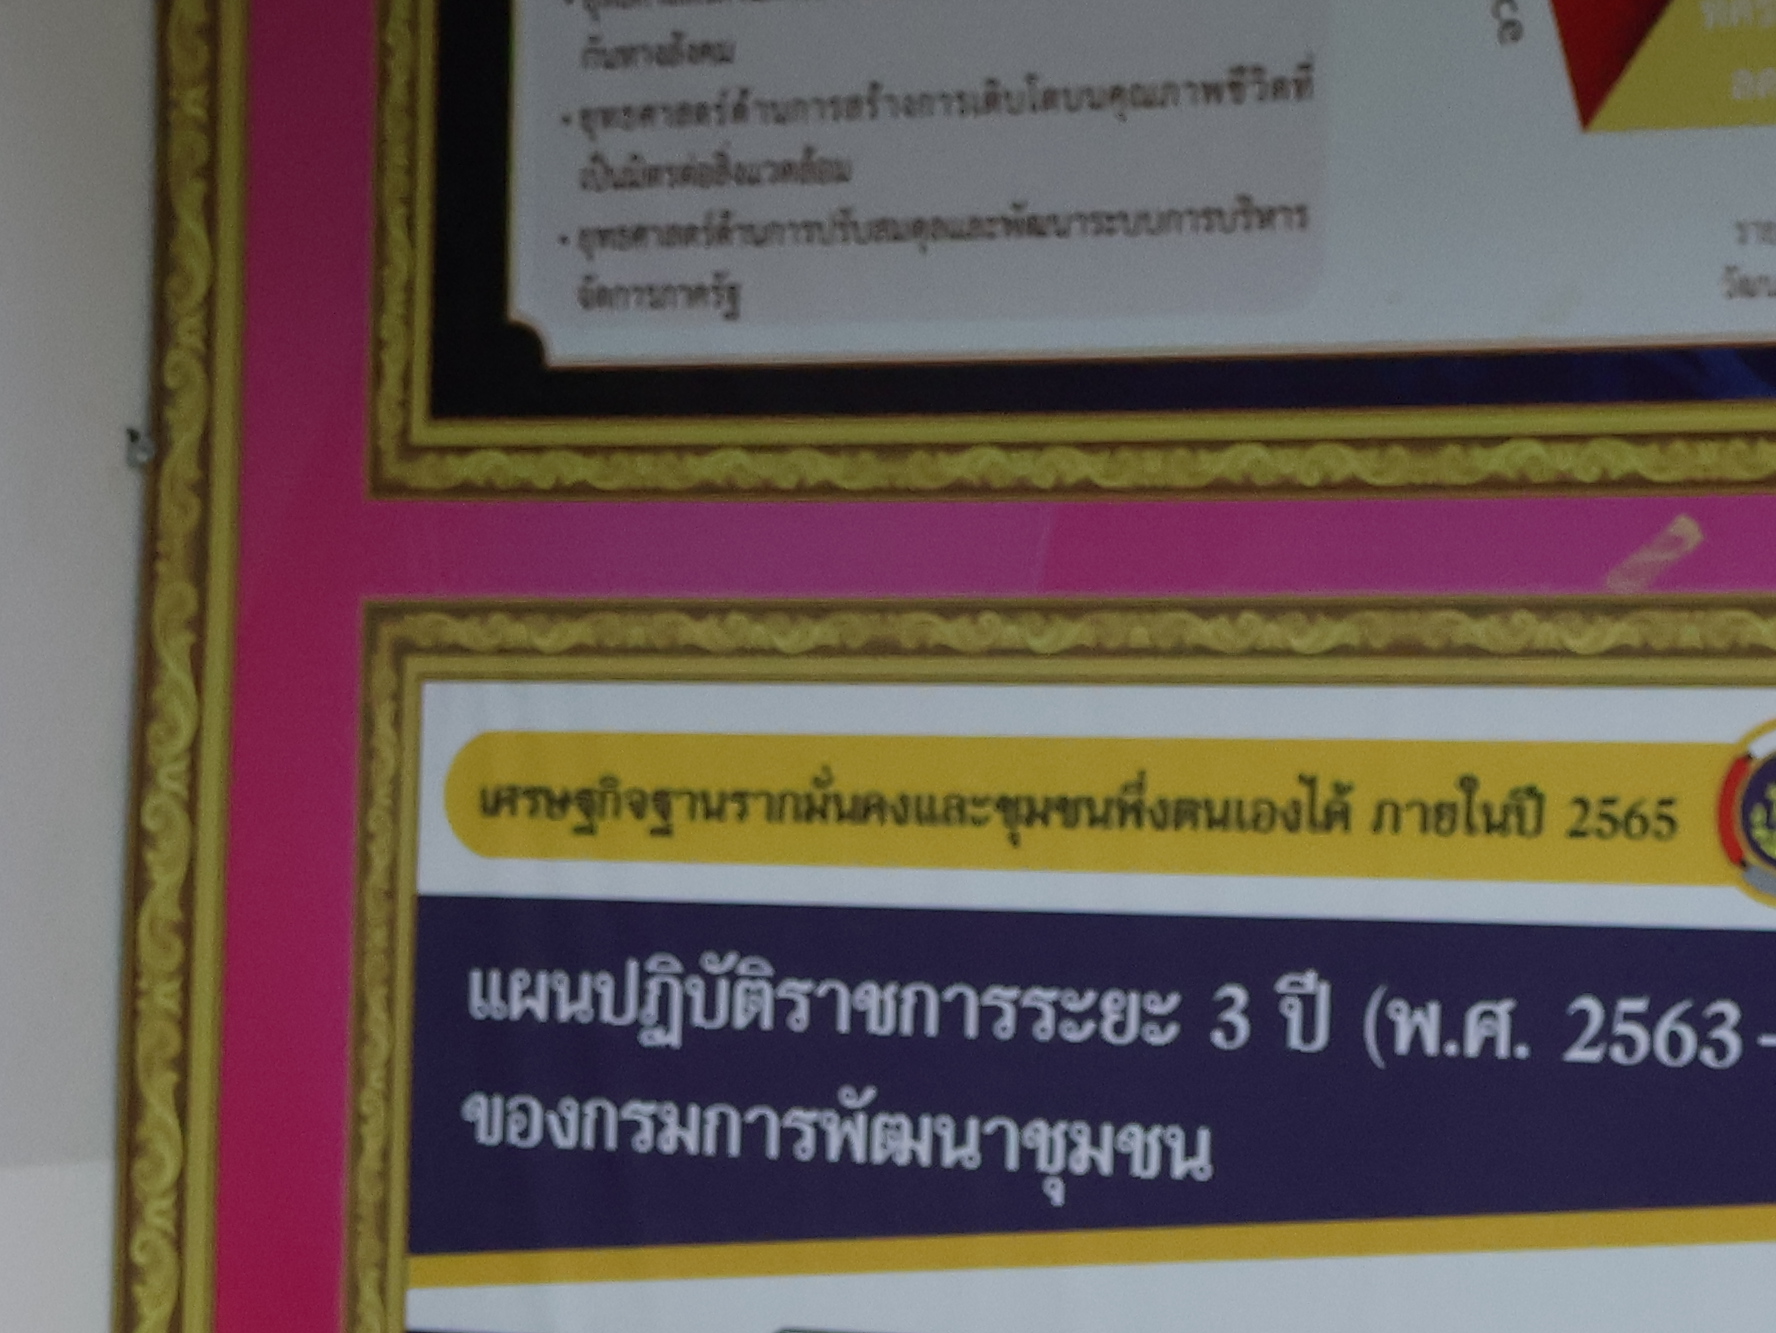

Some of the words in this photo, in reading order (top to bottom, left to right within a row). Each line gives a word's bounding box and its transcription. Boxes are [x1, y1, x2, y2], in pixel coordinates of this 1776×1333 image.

[479, 764, 1355, 848] เศรษฐกิจฐานรากมั่นคงและชุมชนพึ่งตนเองได้
[1371, 775, 1546, 840] ภายในปี
[1566, 796, 1680, 841] 2565
[468, 952, 1181, 1049] แผนปฏิบัติราชการระยะ
[1209, 984, 1250, 1051] 3
[1275, 969, 1332, 1053] ปี
[1363, 985, 1530, 1069] (พ.ศ.
[461, 1085, 1213, 1206] ของกรมการพัฒนาชุมชน
